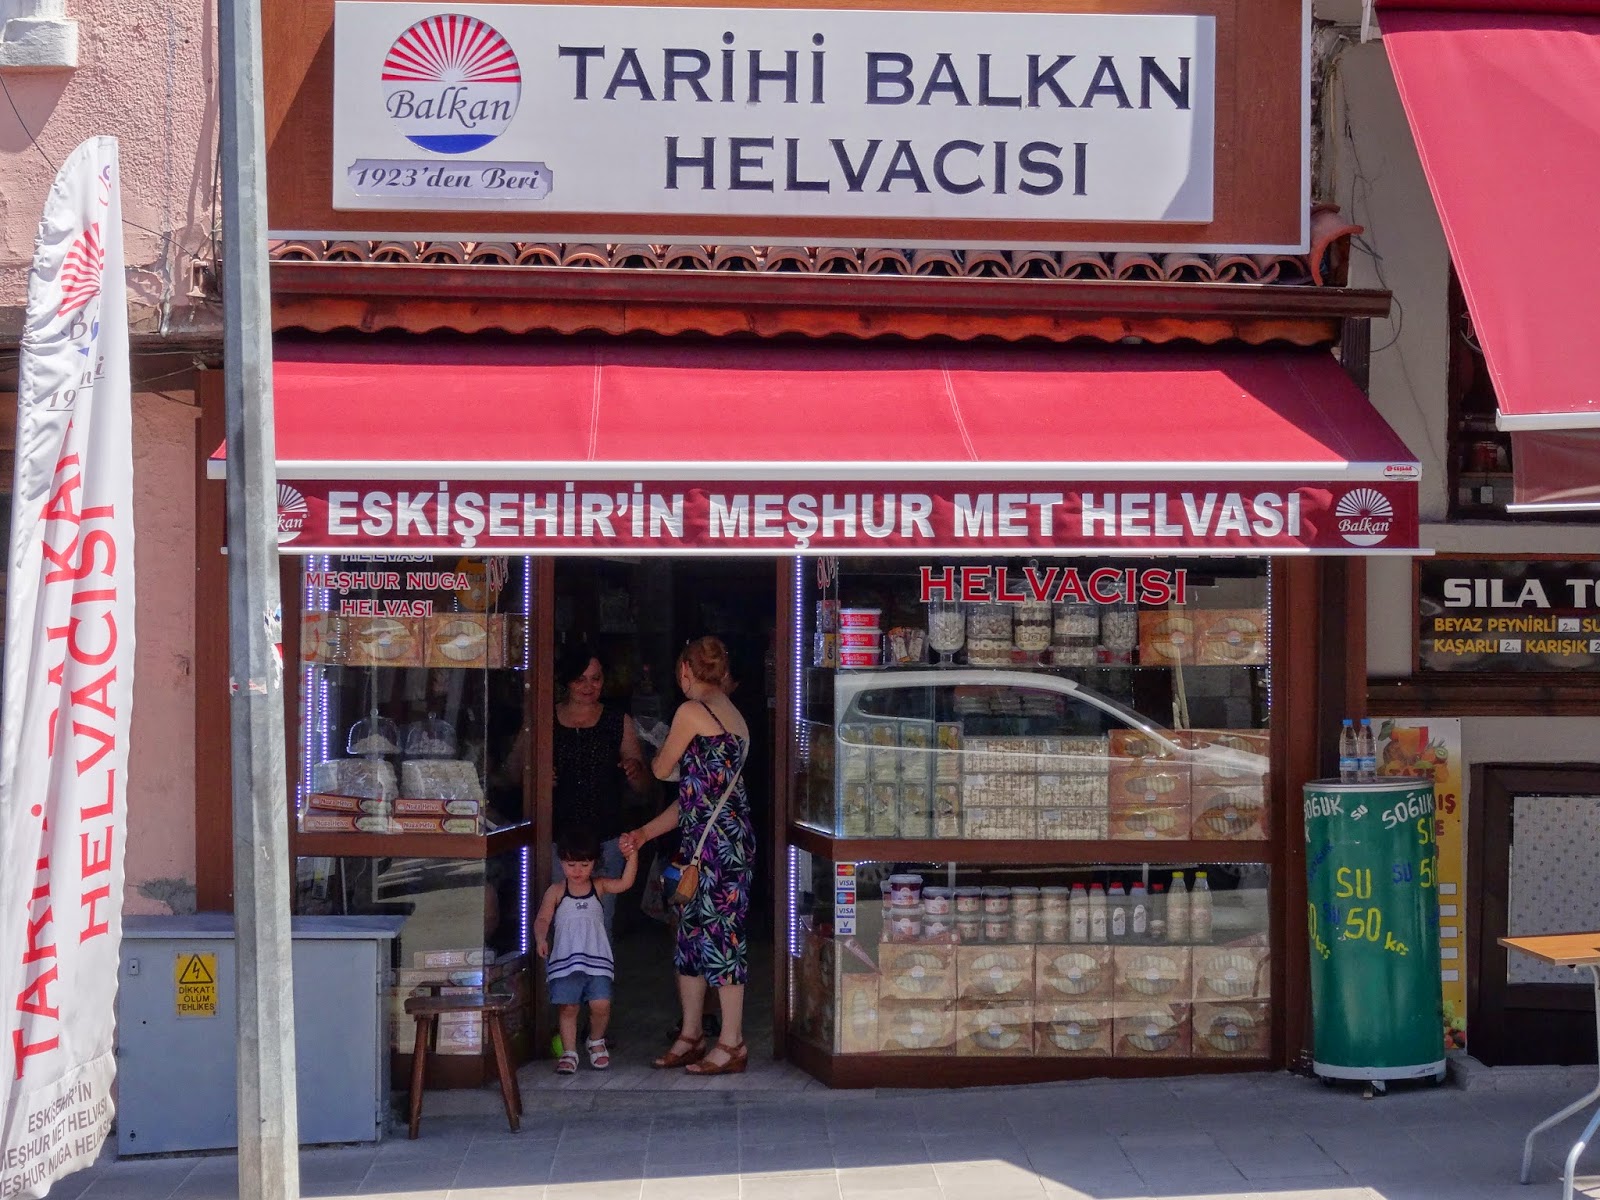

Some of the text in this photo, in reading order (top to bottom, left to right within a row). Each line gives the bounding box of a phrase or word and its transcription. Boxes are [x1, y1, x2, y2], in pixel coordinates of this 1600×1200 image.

[558, 31, 1191, 110] TARİHİ BALKAN
[386, 86, 511, 128] Balkan
[356, 167, 540, 189] 1923'den Beri
[664, 136, 1088, 196] HELVACISI
[276, 513, 303, 531] kan
[328, 481, 1300, 549] ESKİŞEHİR'İN MEŞHUR MET HELVASI
[1338, 517, 1390, 535] Balkan
[305, 571, 401, 595] MEŞHUR
[406, 571, 471, 590] NUGA
[919, 565, 1188, 605] HELVACISI
[1443, 578, 1551, 608] SILA
[339, 600, 433, 618] HELVASI
[1434, 617, 1483, 632] BEYAZ
[1488, 614, 1556, 632] PEYNİRLİ
[1434, 639, 1498, 656] KAŞARLI
[1525, 639, 1588, 657] KARIŞIK
[1434, 793, 1457, 814] IŞ
[1336, 866, 1372, 899] SU
[1344, 907, 1382, 942] 50
[0, 1162, 46, 1200] EŞHUR
